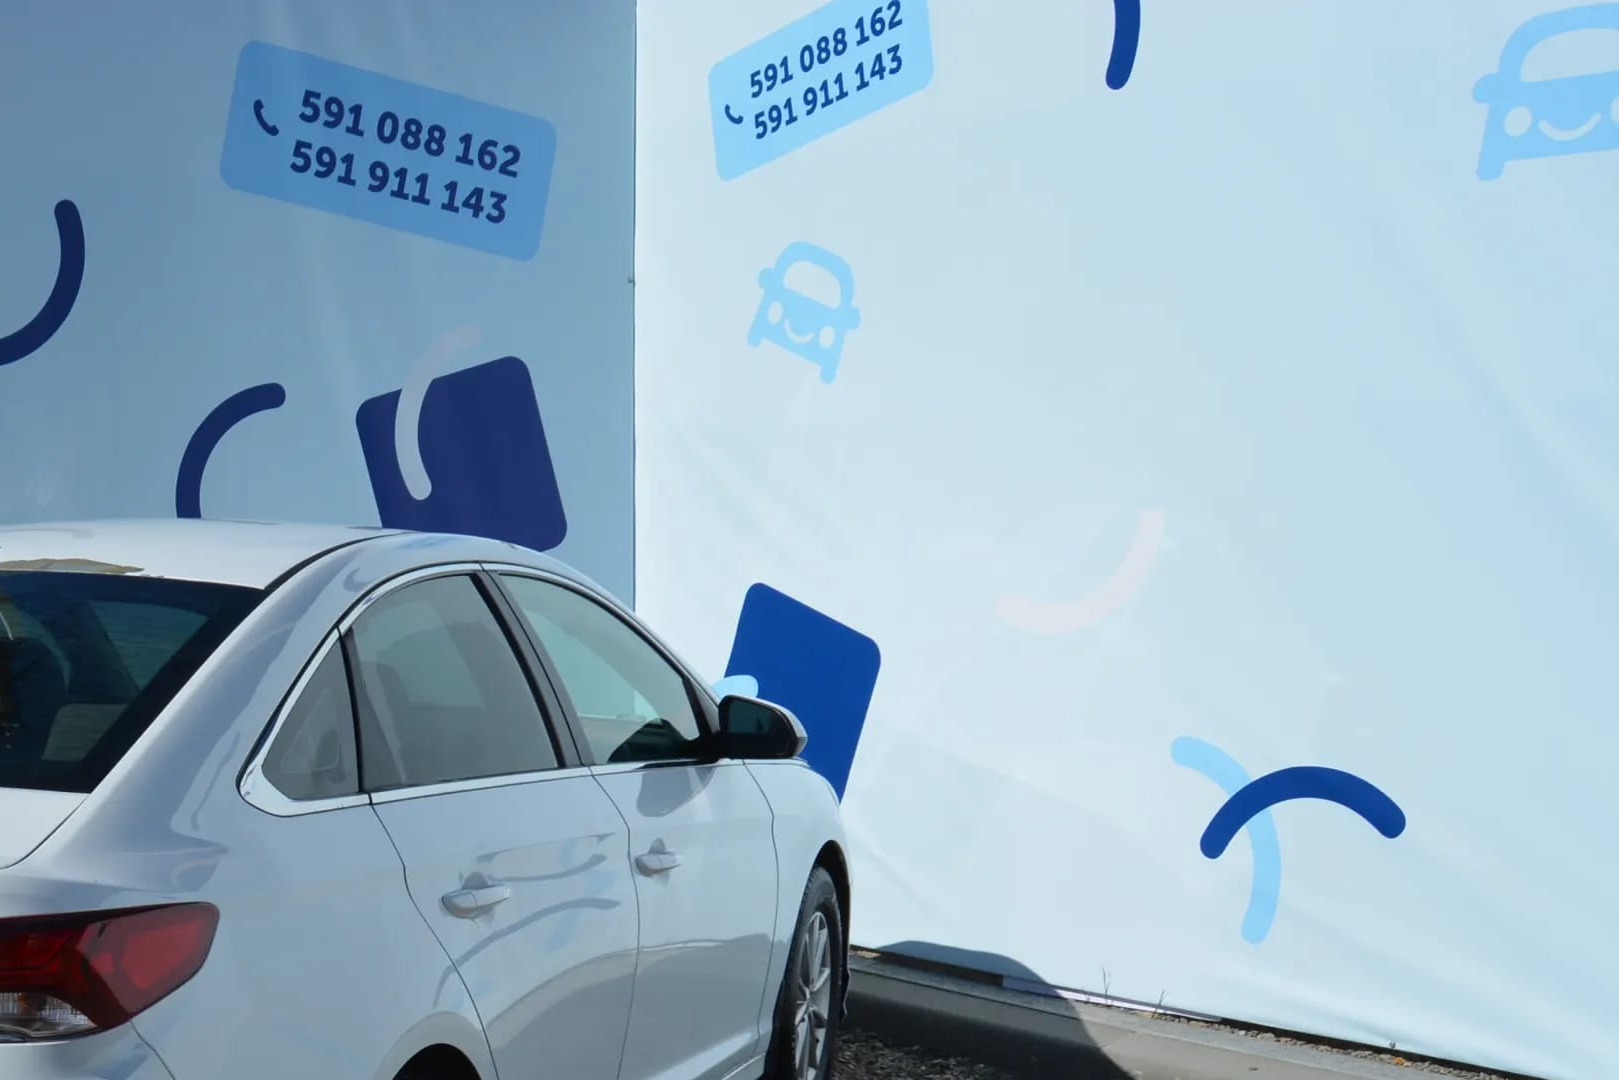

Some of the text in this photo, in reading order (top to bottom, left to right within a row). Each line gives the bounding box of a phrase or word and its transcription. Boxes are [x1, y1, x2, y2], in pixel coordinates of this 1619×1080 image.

[750, 0, 903, 99] 591 088 162
[754, 43, 903, 140] 591 911 143
[298, 88, 521, 179] 591 088 162
[289, 139, 508, 224] 591 911 143
